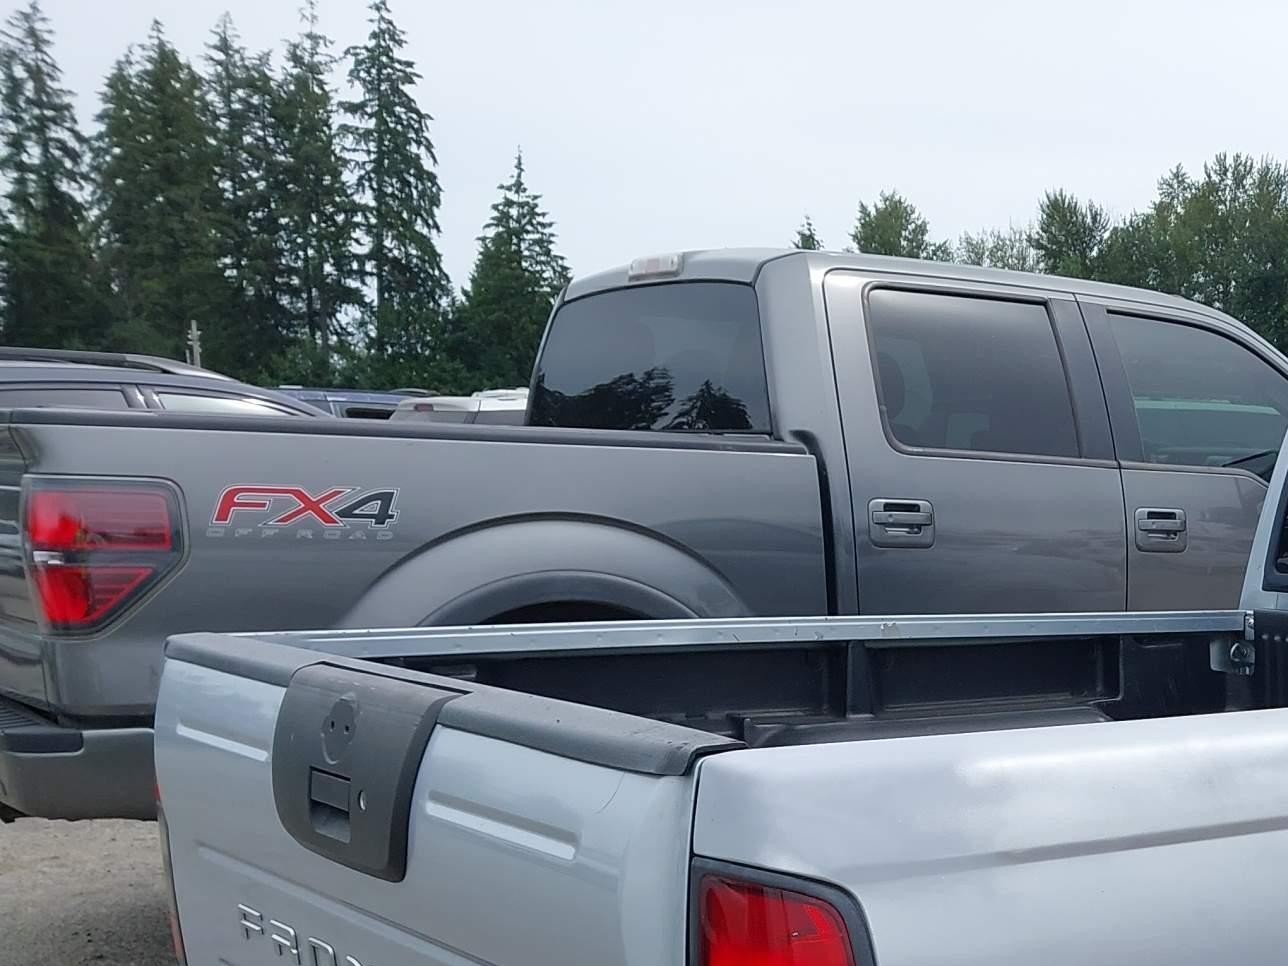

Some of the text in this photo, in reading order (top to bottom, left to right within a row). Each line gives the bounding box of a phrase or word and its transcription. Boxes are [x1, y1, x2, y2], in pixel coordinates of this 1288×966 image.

[209, 485, 402, 528] FX4
[206, 527, 395, 540] OFF ROAD
